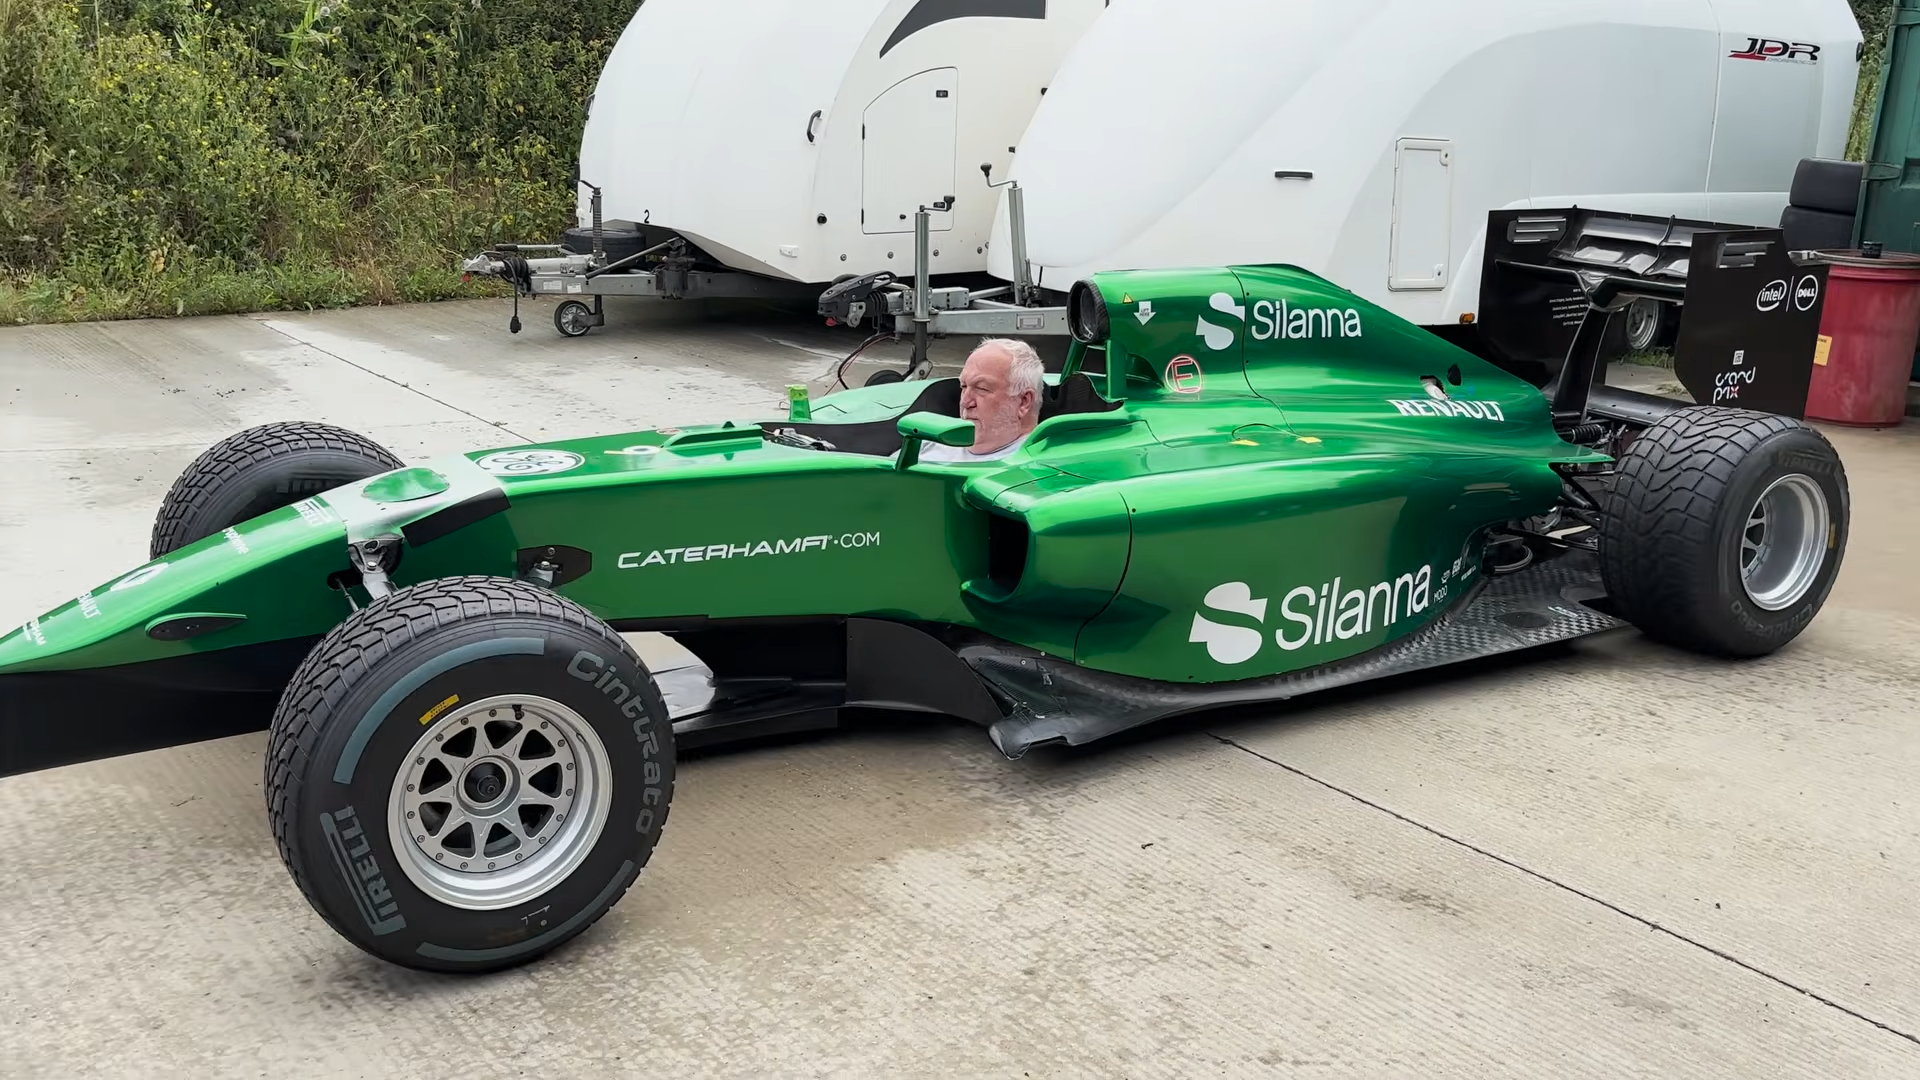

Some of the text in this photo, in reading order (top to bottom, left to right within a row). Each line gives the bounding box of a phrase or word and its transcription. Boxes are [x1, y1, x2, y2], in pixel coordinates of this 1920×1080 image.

[1730, 37, 1821, 61] JDR
[644, 209, 650, 224] 2
[1760, 285, 1815, 302] intel DELL
[1251, 298, 1362, 341] Silanna
[1170, 358, 1201, 393] E
[1386, 399, 1505, 422] RENAULT
[1275, 564, 1431, 651] Silanna
[566, 650, 663, 835] Cinturato
[320, 804, 407, 936] PIRELLI
